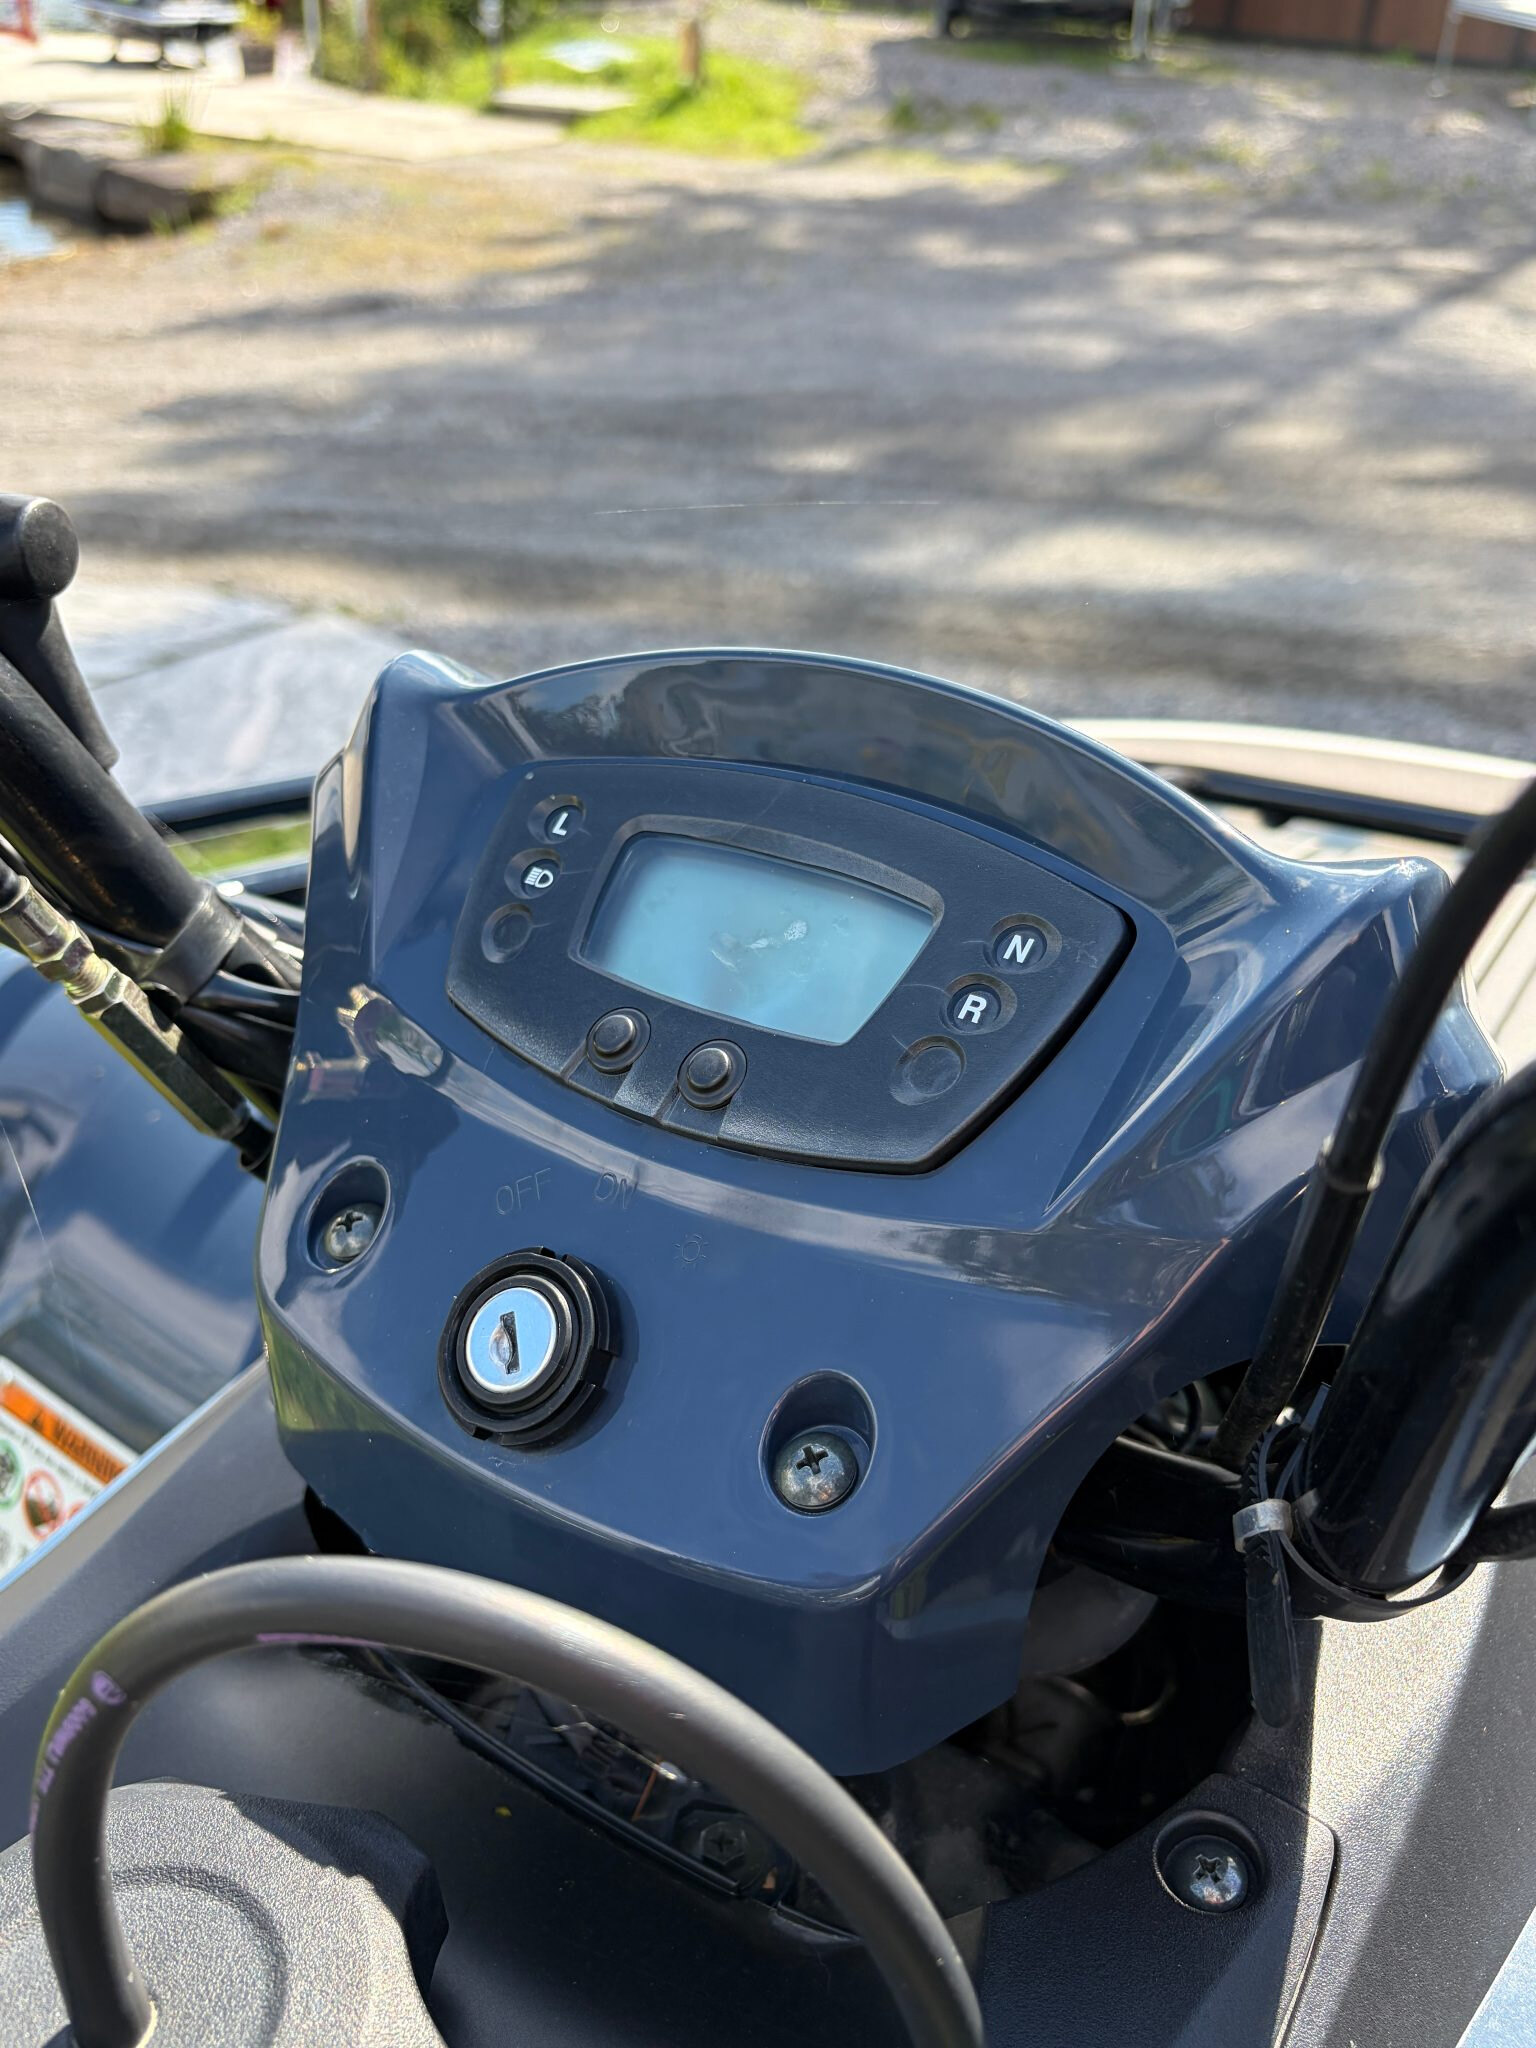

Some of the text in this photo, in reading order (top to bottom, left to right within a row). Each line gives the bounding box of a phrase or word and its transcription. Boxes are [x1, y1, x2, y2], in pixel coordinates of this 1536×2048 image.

[552, 811, 569, 836] L
[1002, 934, 1035, 964] N
[957, 994, 987, 1024] R
[496, 1167, 551, 1215] OFF
[594, 1163, 641, 1210] ON
